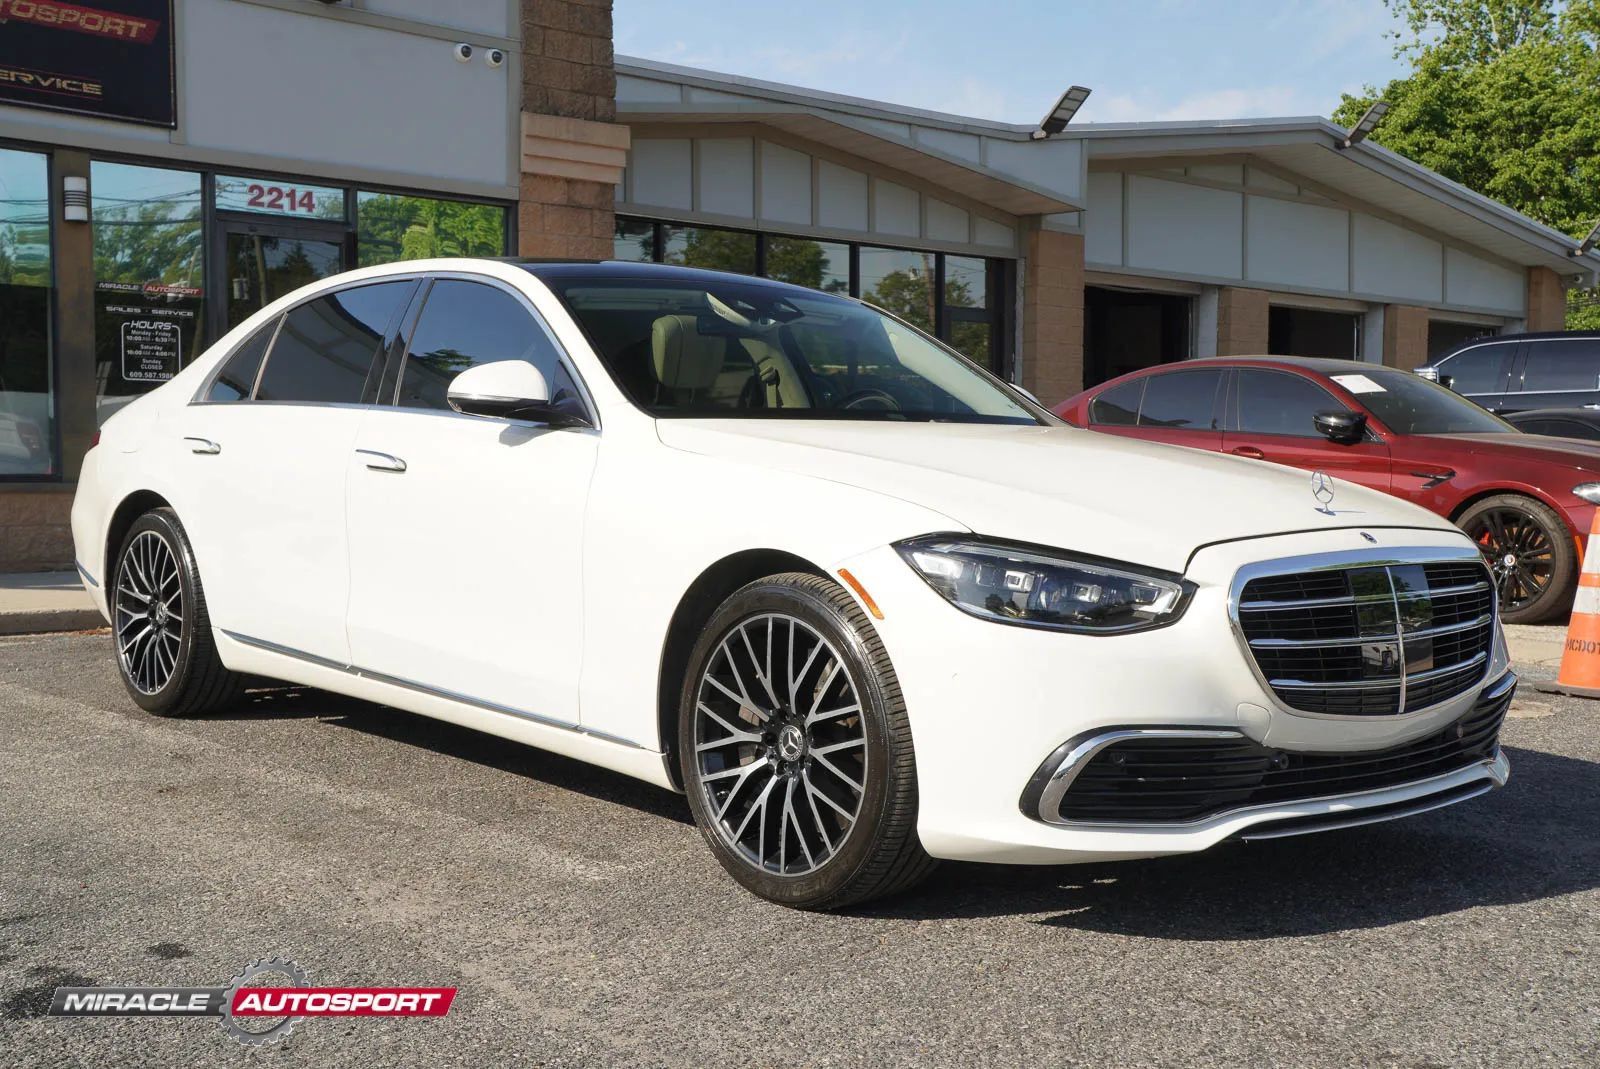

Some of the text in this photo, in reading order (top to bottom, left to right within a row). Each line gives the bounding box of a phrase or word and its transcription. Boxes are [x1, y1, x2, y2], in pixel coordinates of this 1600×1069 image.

[247, 184, 315, 213] 2214
[99, 282, 200, 295] MIRACLE AUTOSPORT
[152, 309, 194, 317] SERVICE
[130, 320, 172, 329] HOURS
